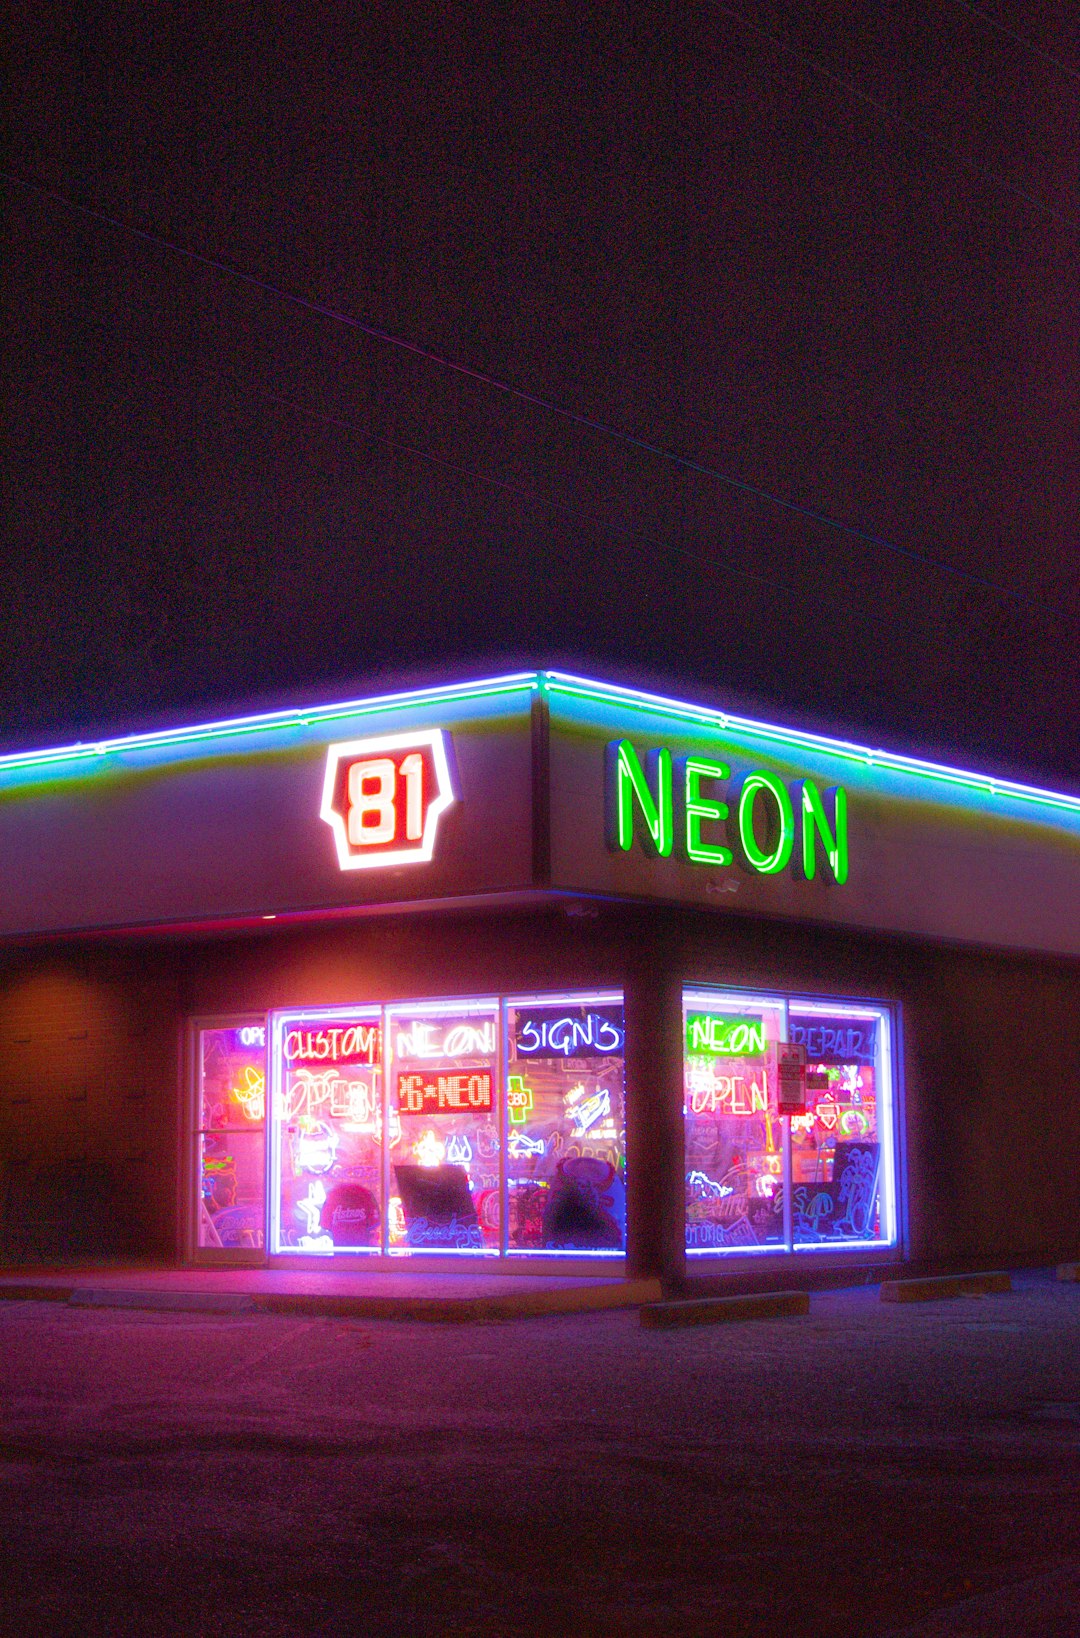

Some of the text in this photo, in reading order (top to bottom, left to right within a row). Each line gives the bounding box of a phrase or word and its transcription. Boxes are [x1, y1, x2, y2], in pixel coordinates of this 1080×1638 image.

[348, 753, 423, 846] 81
[612, 738, 848, 885] NEON
[284, 1025, 377, 1065] CUSTOM
[397, 1020, 495, 1058] NEON
[517, 1014, 621, 1055] SIGNS
[692, 1015, 767, 1053] NEON
[507, 1092, 527, 1107] CBD
[692, 1070, 768, 1114] OPEN
